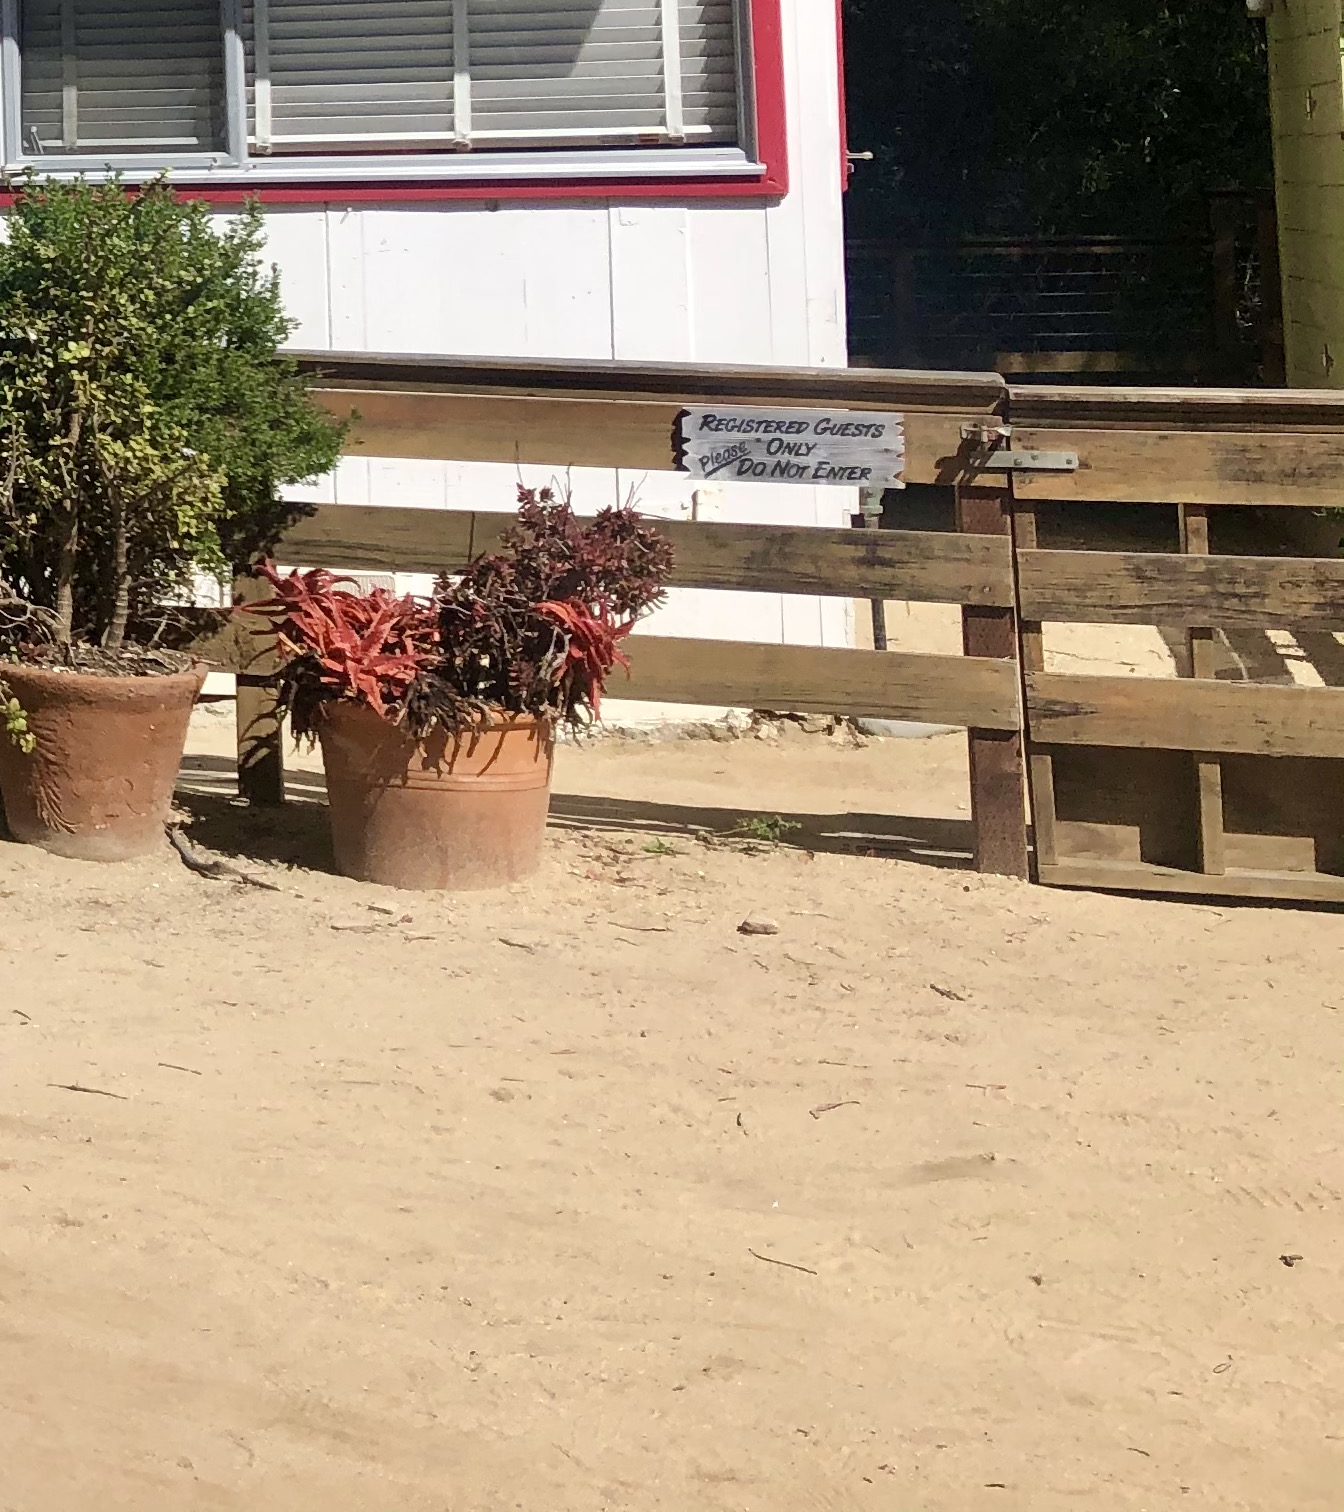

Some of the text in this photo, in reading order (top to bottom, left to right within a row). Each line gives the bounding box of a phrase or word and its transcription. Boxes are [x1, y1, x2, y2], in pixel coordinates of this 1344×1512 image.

[698, 414, 886, 438] REGISTERED GUESTS
[698, 441, 748, 472] Please
[766, 438, 817, 457] ONLY
[736, 458, 873, 481] DO NOT ENTER
